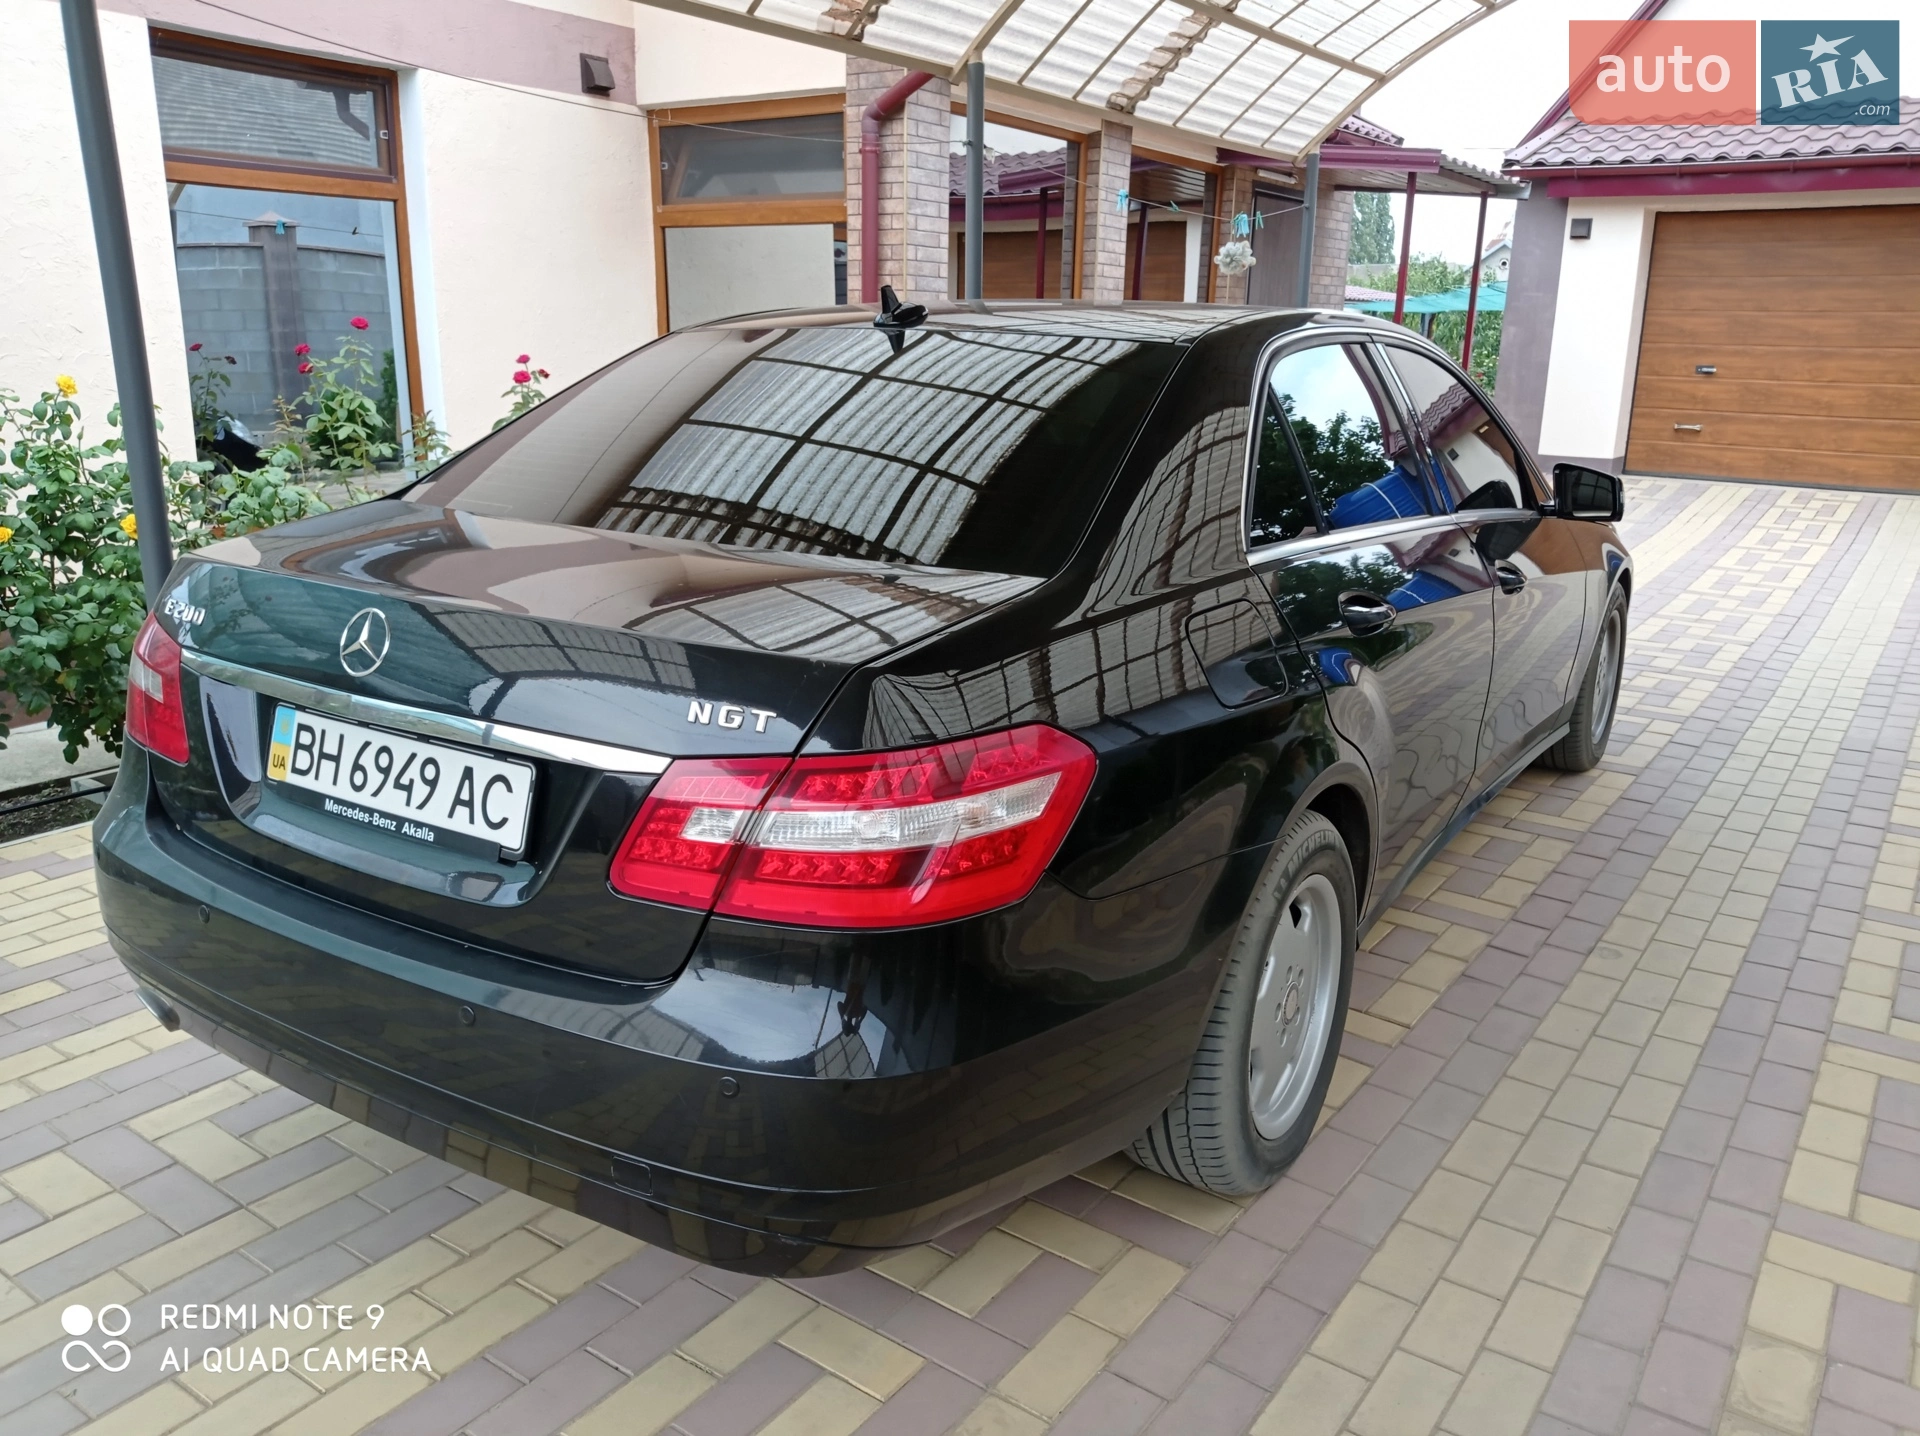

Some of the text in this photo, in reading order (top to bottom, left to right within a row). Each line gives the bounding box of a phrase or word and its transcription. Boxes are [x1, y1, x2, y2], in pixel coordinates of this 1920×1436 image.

[687, 700, 777, 733] NGT
[272, 753, 286, 771] UA
[290, 722, 514, 831] BH 6949 AC
[324, 798, 435, 843] Mercedes-Benz Akalla
